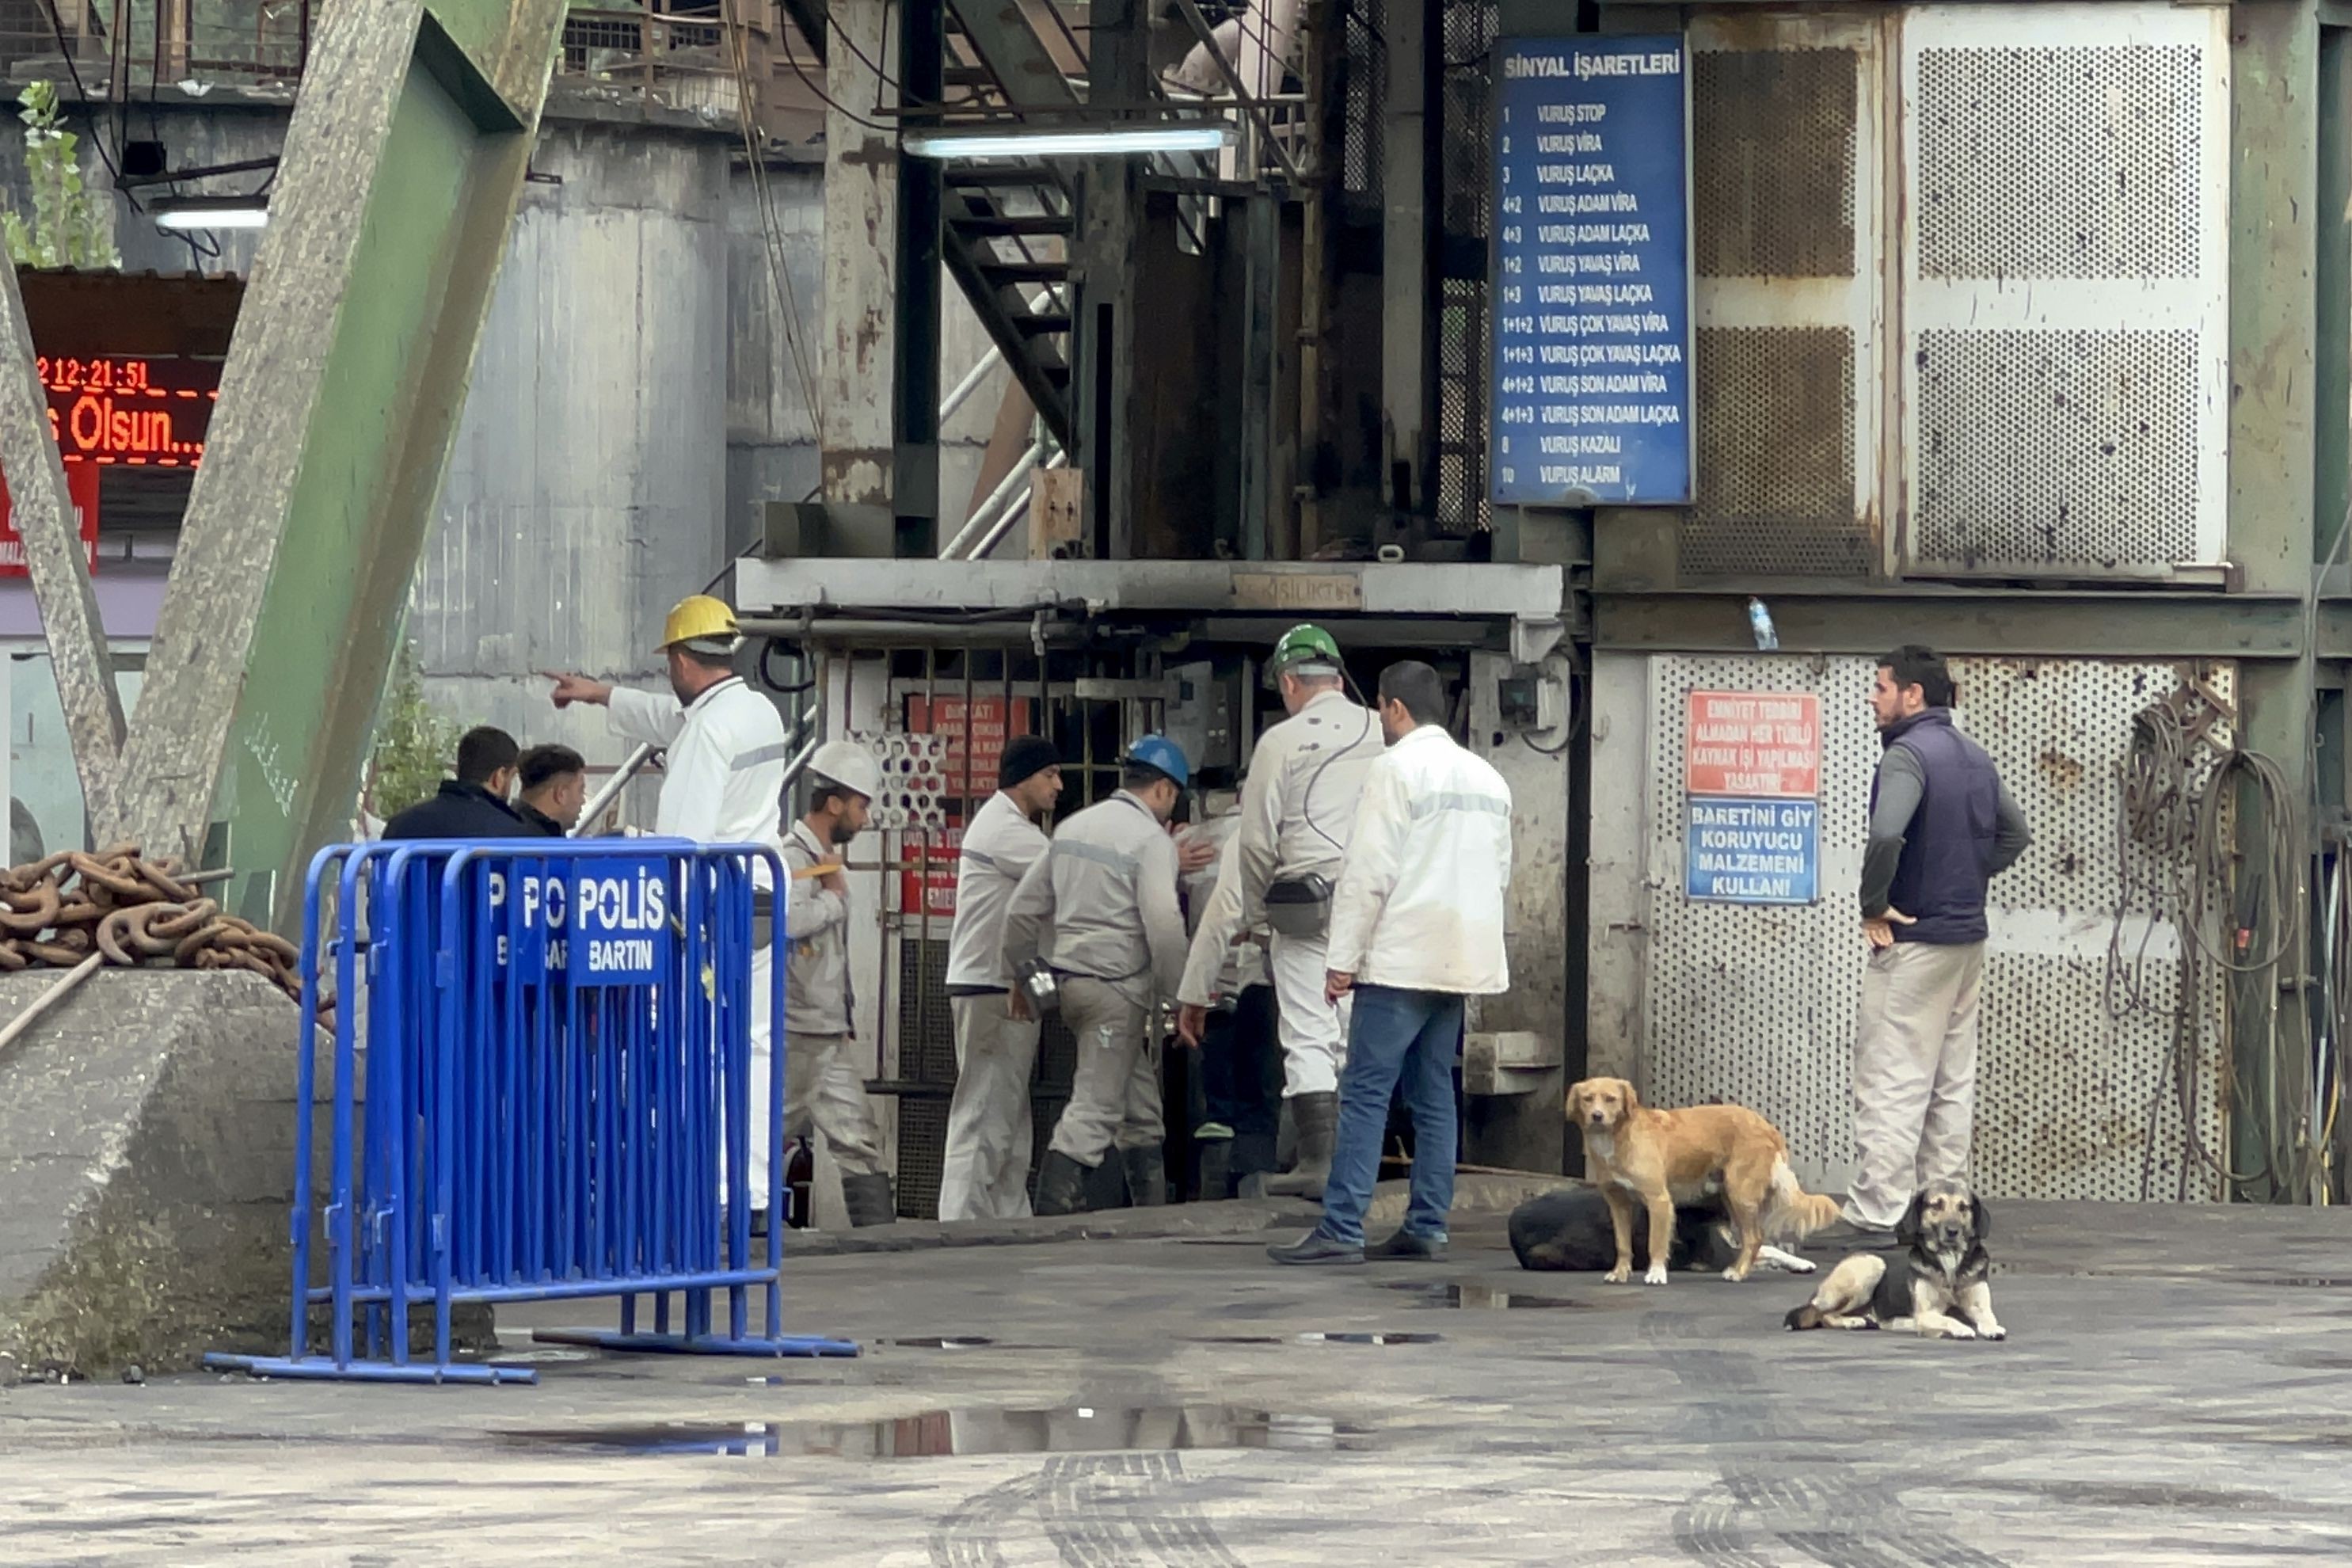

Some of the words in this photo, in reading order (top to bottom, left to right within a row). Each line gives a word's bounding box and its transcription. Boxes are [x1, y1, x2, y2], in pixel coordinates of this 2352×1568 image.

[1505, 53, 1569, 78] SİNYAL
[1574, 49, 1680, 81] İŞARETLERİ
[1504, 106, 1509, 123] 1
[1537, 105, 1575, 125] VURUŞ
[1577, 104, 1606, 122] STOP
[1502, 136, 1509, 154] 2
[1536, 135, 1575, 156] VURUŞ
[1577, 130, 1603, 151] VİRA
[1502, 166, 1509, 183] 3
[1536, 165, 1575, 186] VURUŞ
[1577, 165, 1615, 186] LAÇKA
[1537, 195, 1576, 216] VURUŞ
[1578, 195, 1609, 212] ADAM
[1611, 190, 1638, 211] VİRA
[1537, 224, 1576, 246] VURUŞ
[1578, 224, 1609, 242] ADAM
[1611, 224, 1650, 245] LAÇKA
[1537, 255, 1576, 277] VURUŞ
[1578, 254, 1612, 276] YAVAŞ
[1613, 250, 1640, 272] VİRA
[1538, 285, 1577, 306] VURUŞ
[1578, 284, 1612, 306] YAVAŞ
[1614, 284, 1653, 306] LAÇKA
[1539, 314, 1578, 337] VURUŞ
[1580, 314, 1604, 337] ÇOK
[1605, 314, 1641, 337] YAVAŞ
[1642, 310, 1669, 332] VİRA
[1539, 345, 1578, 367] VURUŞ
[1581, 345, 1605, 367] ÇOK
[1606, 345, 1641, 366] YAVAŞ
[1643, 345, 1681, 366] LAÇKA
[55, 358, 147, 388] 12:21:51
[1539, 375, 1578, 398] VURUŞ
[1581, 375, 1605, 393] SON
[1606, 375, 1638, 393] ADAM
[1641, 370, 1668, 393] VİRA
[1540, 405, 1578, 427] VURUŞ
[1581, 405, 1605, 423] SON
[1606, 405, 1638, 423] ADAM
[1641, 405, 1680, 427] LAÇKA
[1540, 436, 1579, 458] VURUŞ
[1539, 466, 1579, 486] VURUŞ
[1581, 466, 1620, 483] ALARM
[1695, 722, 1748, 742] ALMADAN
[1751, 722, 1773, 744] HER
[1692, 805, 1775, 827] BARETİNİ
[1781, 806, 1813, 827] GİY
[1701, 831, 1802, 851] KORUYUCU
[1699, 853, 1804, 874] MALZEMENİ
[579, 865, 664, 931] POLİS
[588, 939, 653, 971] BARTIN
